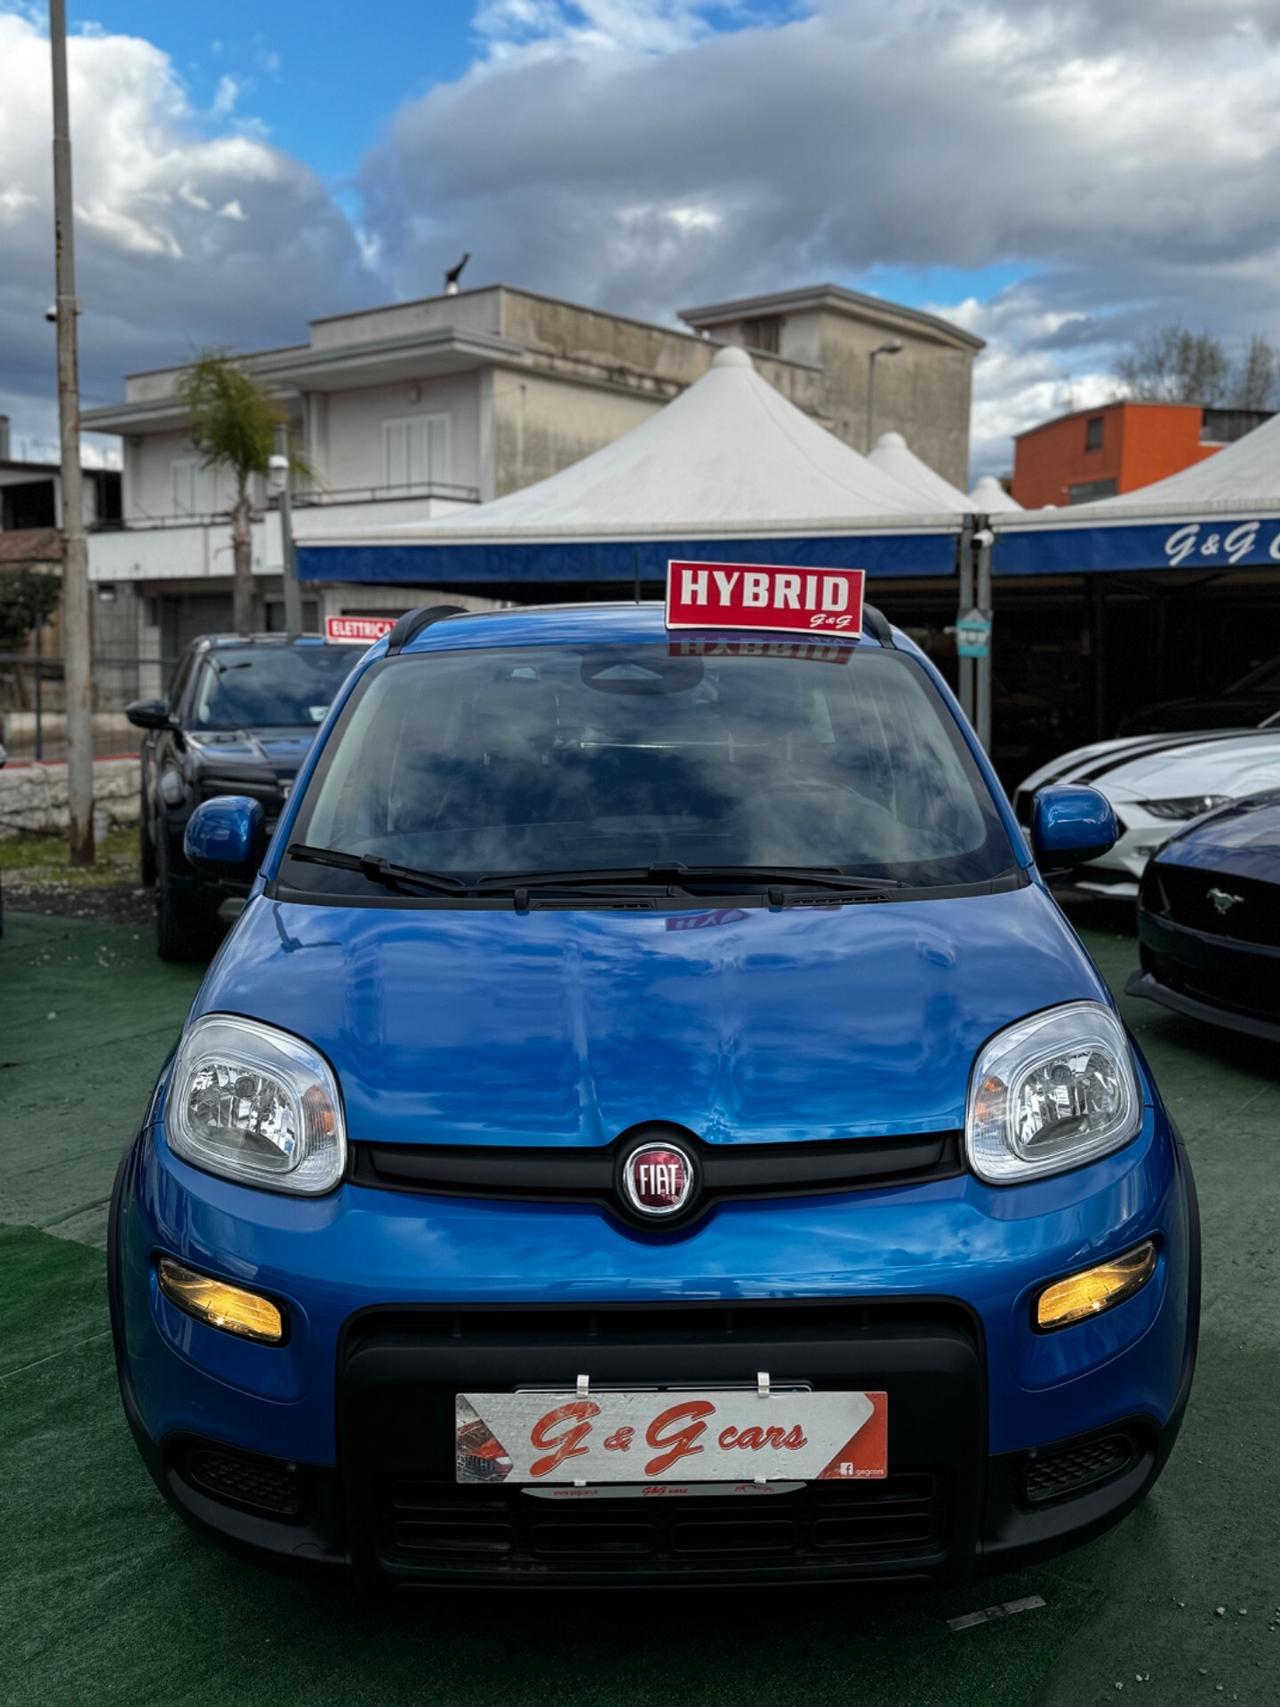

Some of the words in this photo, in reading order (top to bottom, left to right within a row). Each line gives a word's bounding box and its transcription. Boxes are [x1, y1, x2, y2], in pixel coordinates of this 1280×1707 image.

[680, 569, 849, 612] HYBRID
[640, 1164, 679, 1195] FIAT
[718, 1423, 808, 1451] cars
